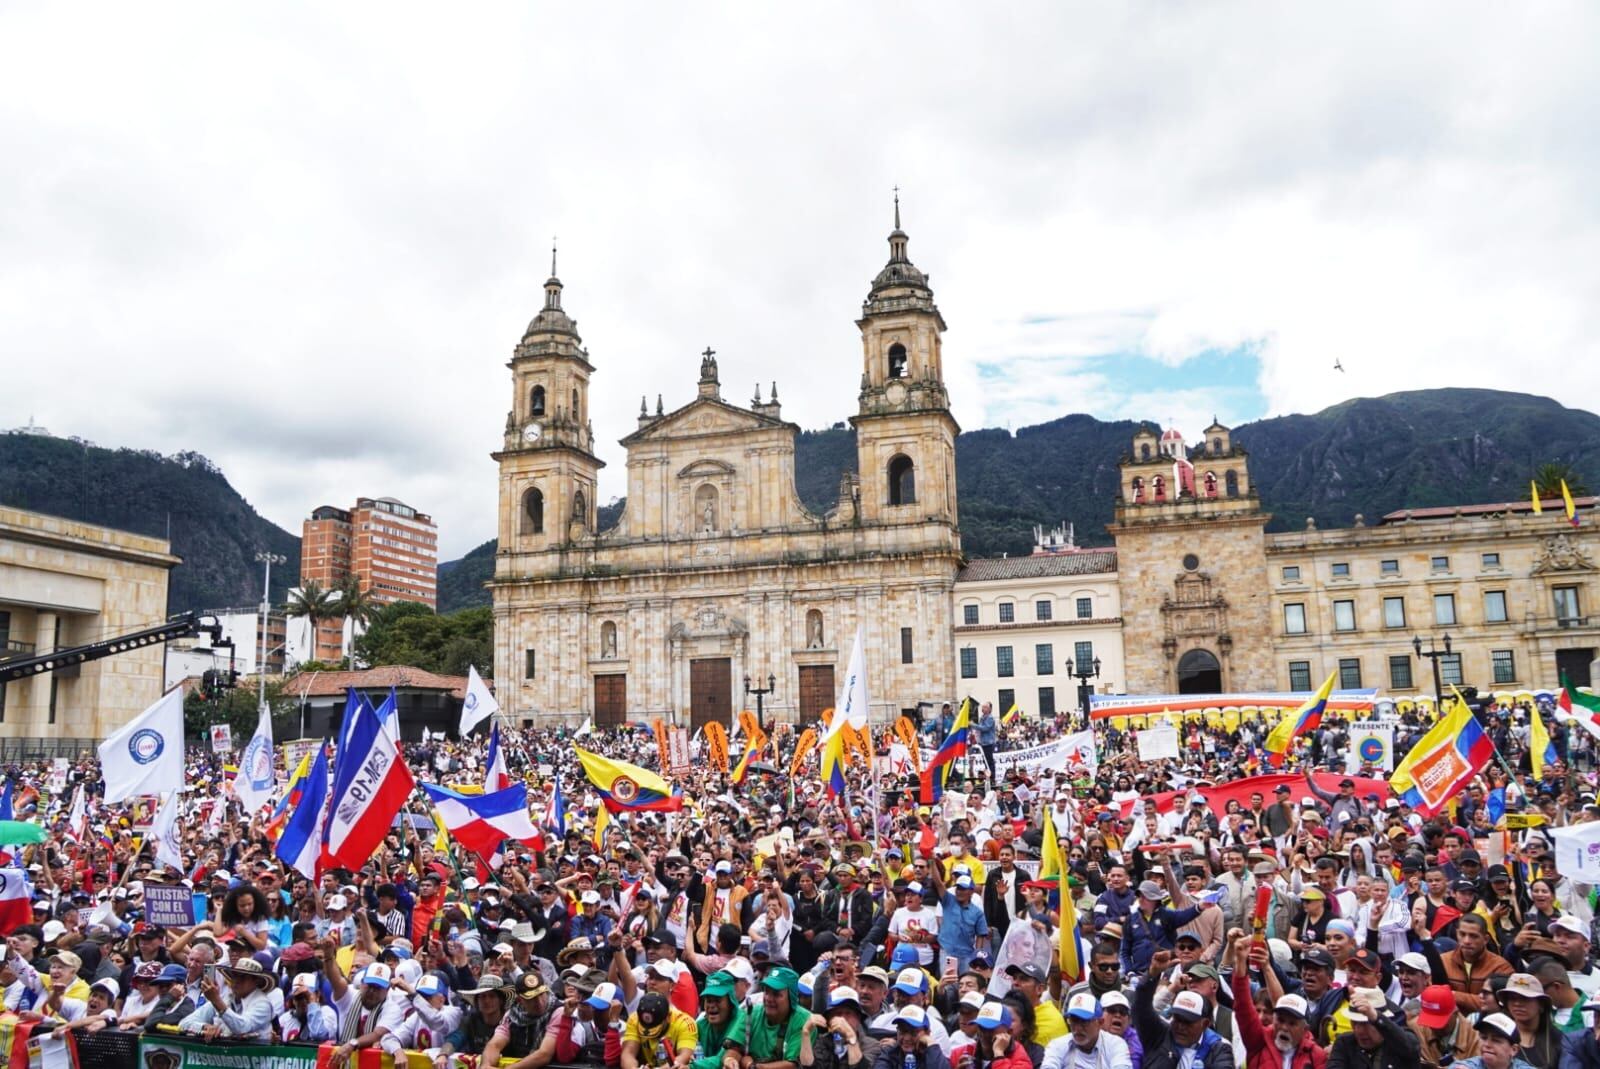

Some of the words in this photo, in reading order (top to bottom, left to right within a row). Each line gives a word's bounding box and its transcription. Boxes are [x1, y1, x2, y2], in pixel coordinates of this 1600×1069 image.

[145, 887, 190, 901] ARTISTAS
[152, 900, 171, 912] CON
[173, 901, 184, 912] EL
[150, 912, 189, 925] CAMBIO
[187, 1050, 251, 1068] RESGUARDO
